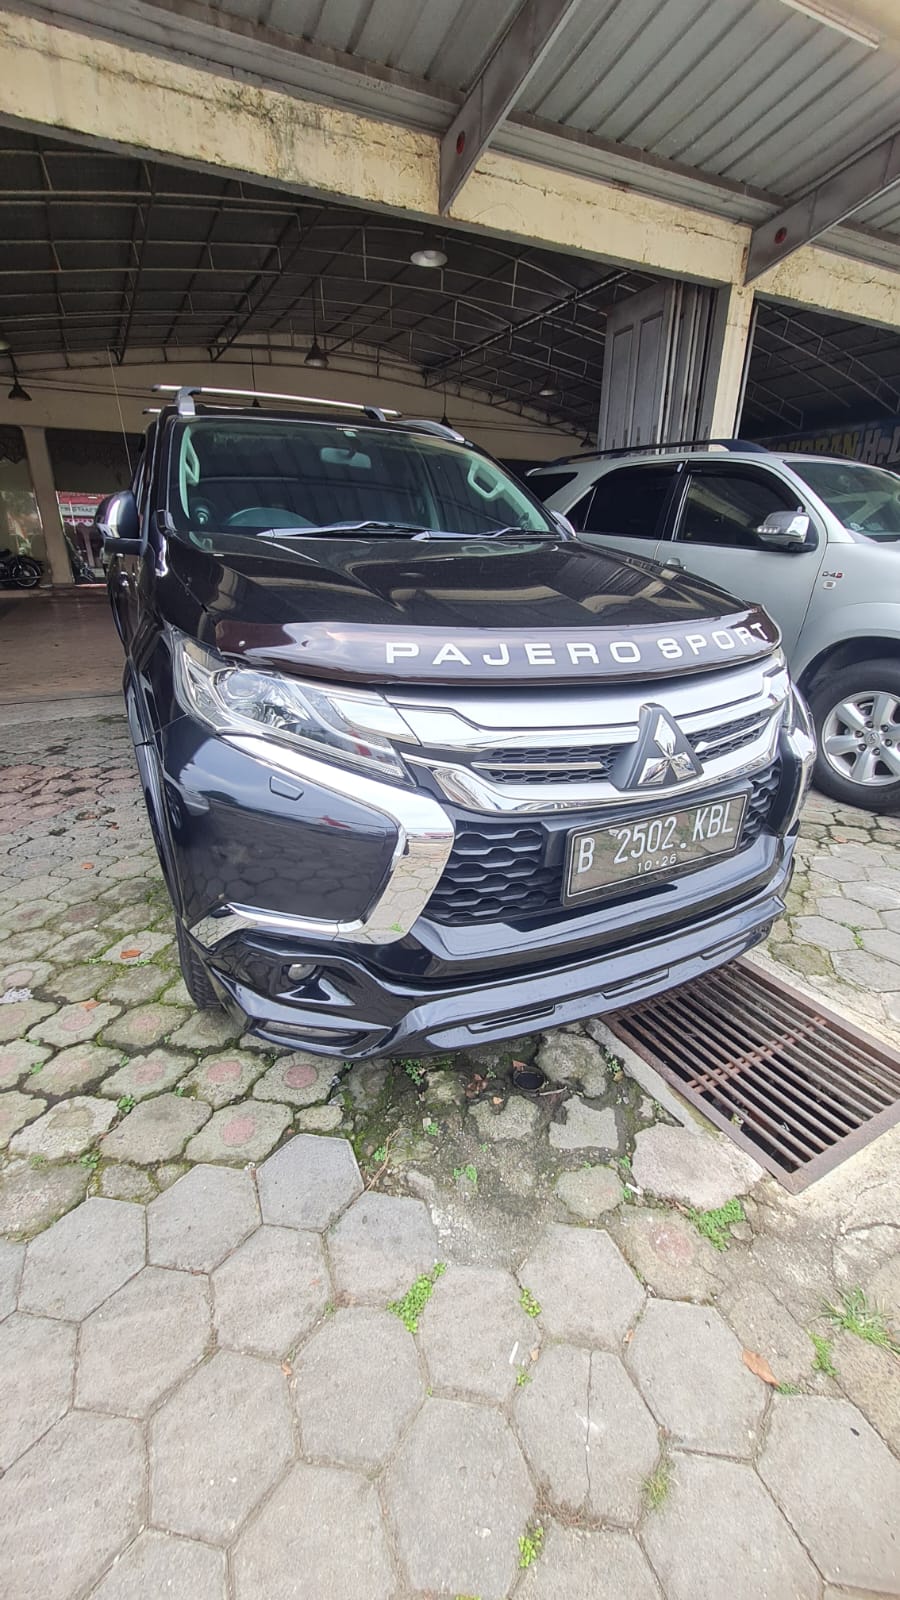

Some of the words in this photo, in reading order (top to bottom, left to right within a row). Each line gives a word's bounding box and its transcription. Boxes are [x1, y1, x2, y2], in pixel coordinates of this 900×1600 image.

[385, 641, 641, 665] PAJERO
[657, 622, 768, 658] SPORT
[577, 838, 595, 873] B
[692, 801, 734, 841] KBL
